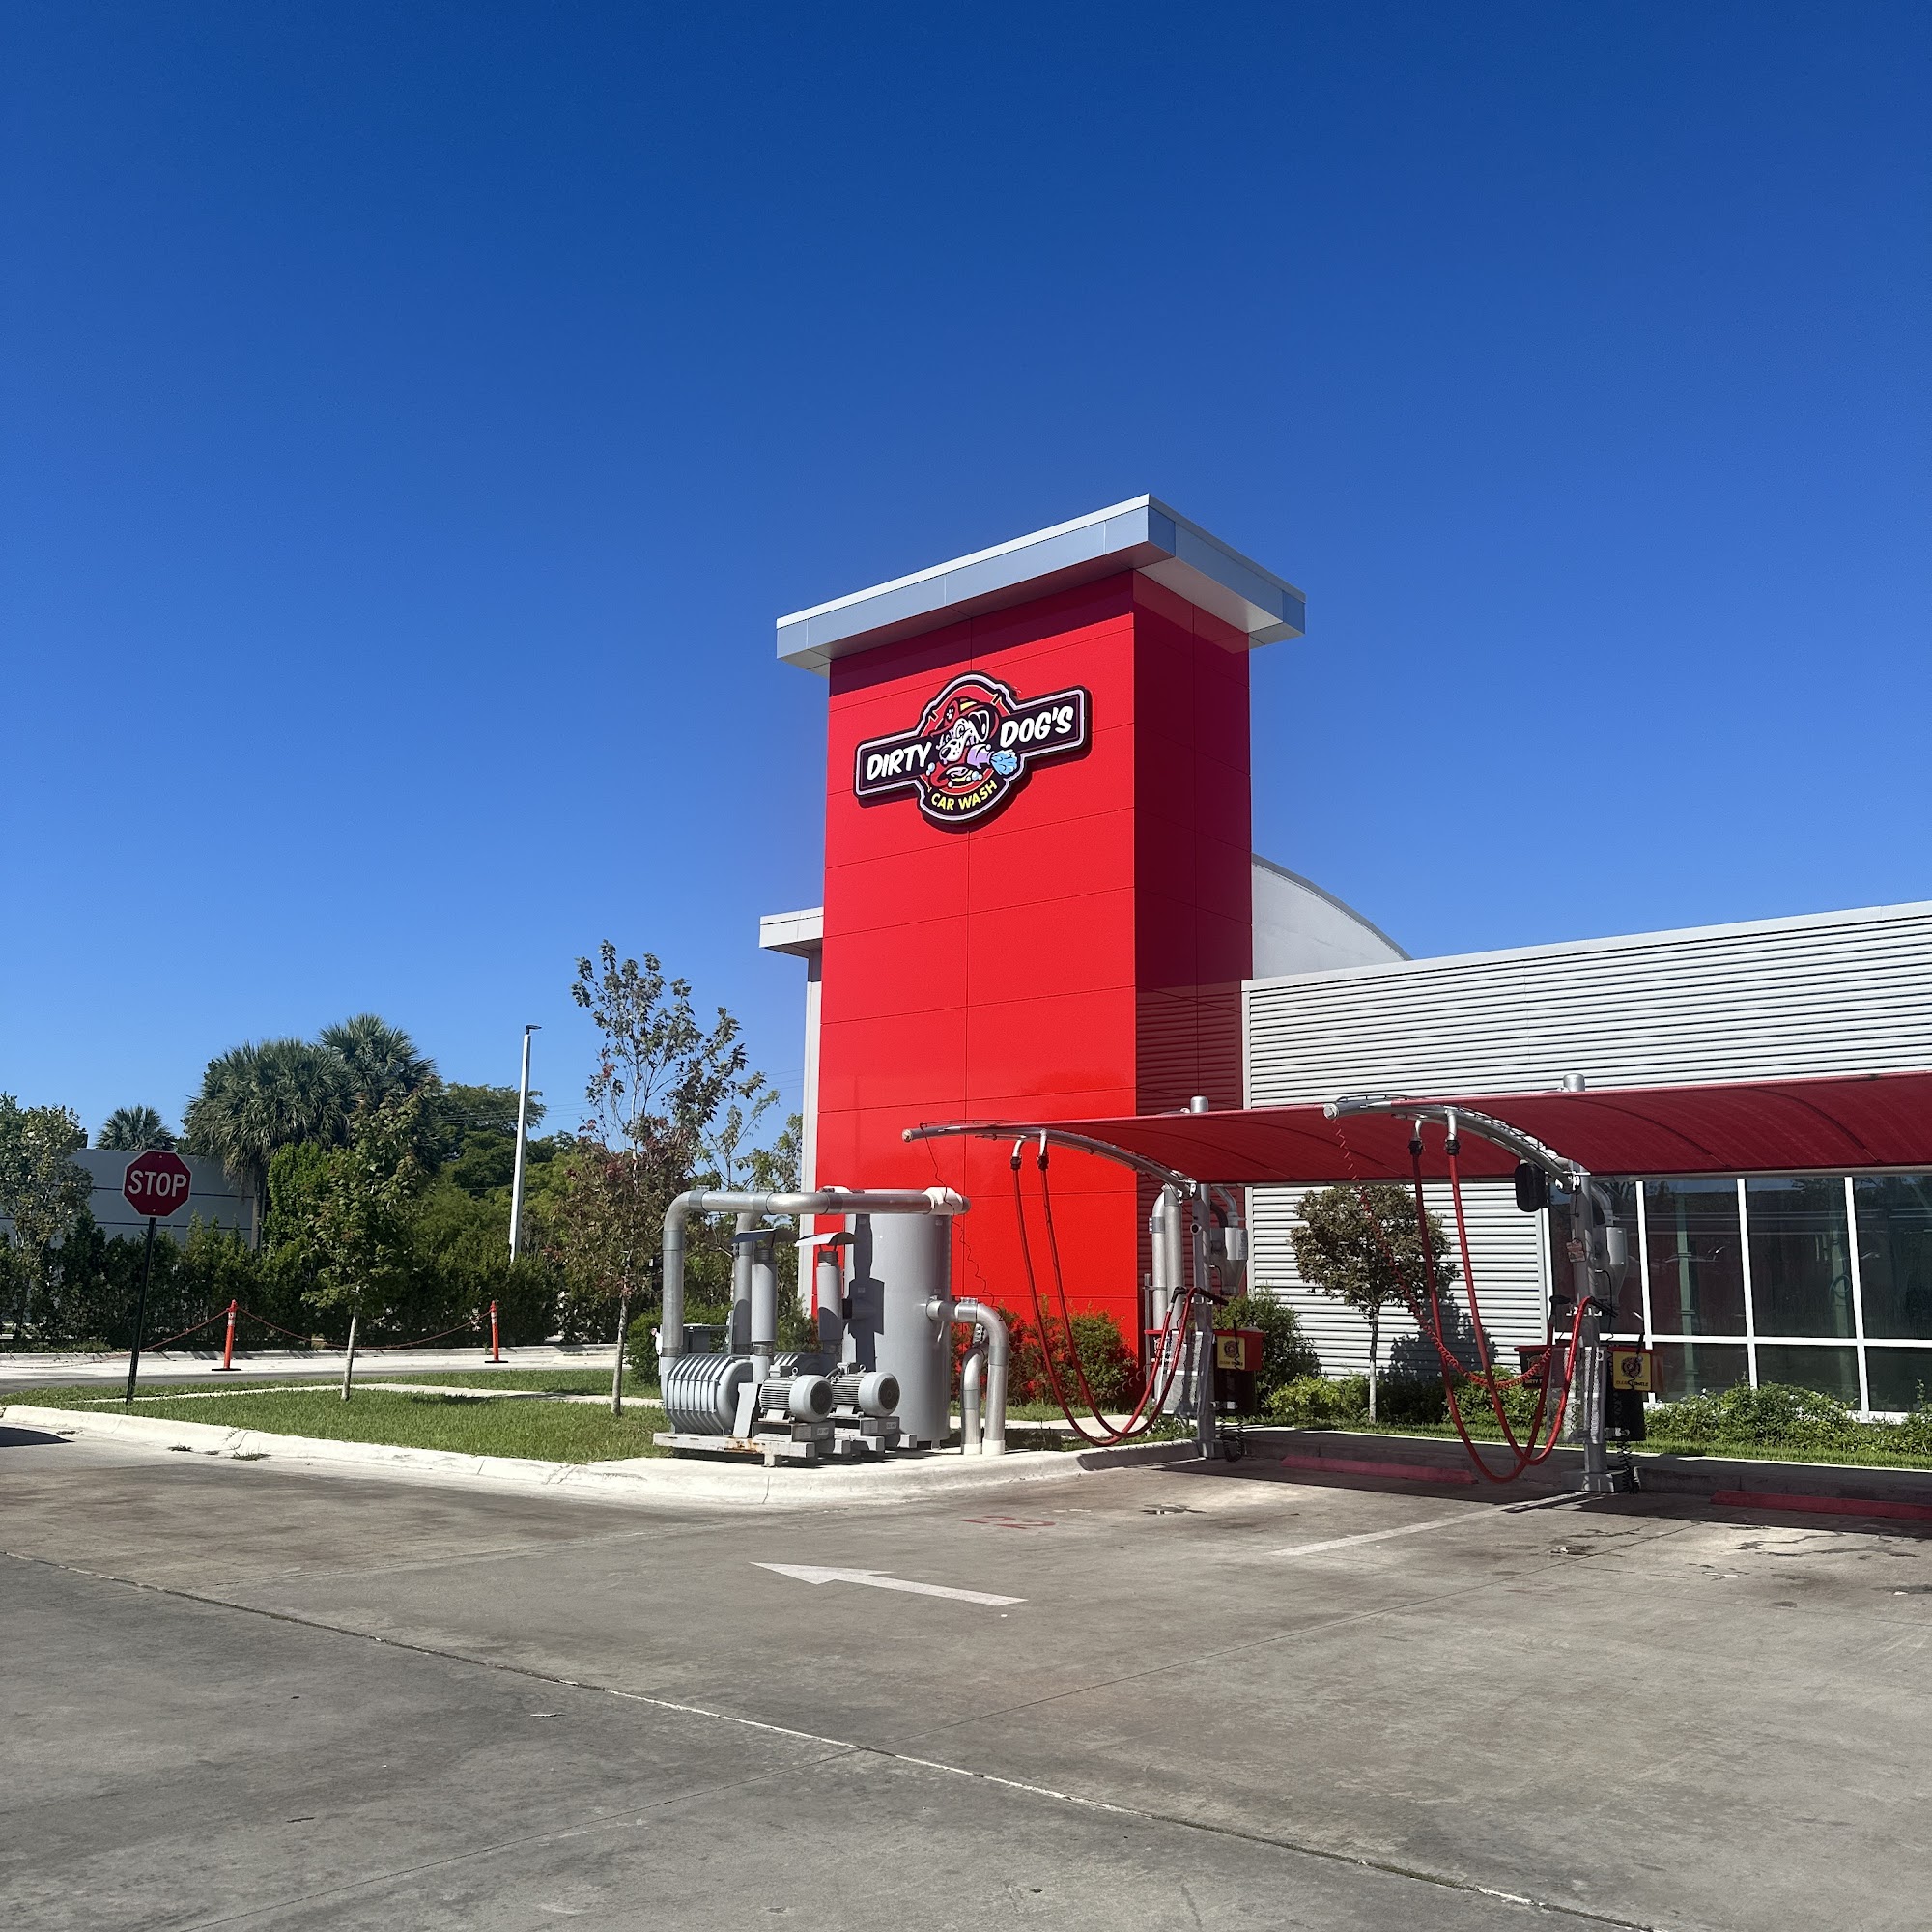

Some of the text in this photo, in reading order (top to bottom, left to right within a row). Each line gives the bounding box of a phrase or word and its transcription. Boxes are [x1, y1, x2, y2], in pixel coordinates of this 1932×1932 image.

[867, 705, 1074, 781] DIRTY DOG'S
[931, 779, 998, 810] CAR WASH
[128, 1169, 187, 1197] STOP
[953, 1515, 1056, 1529] 22
